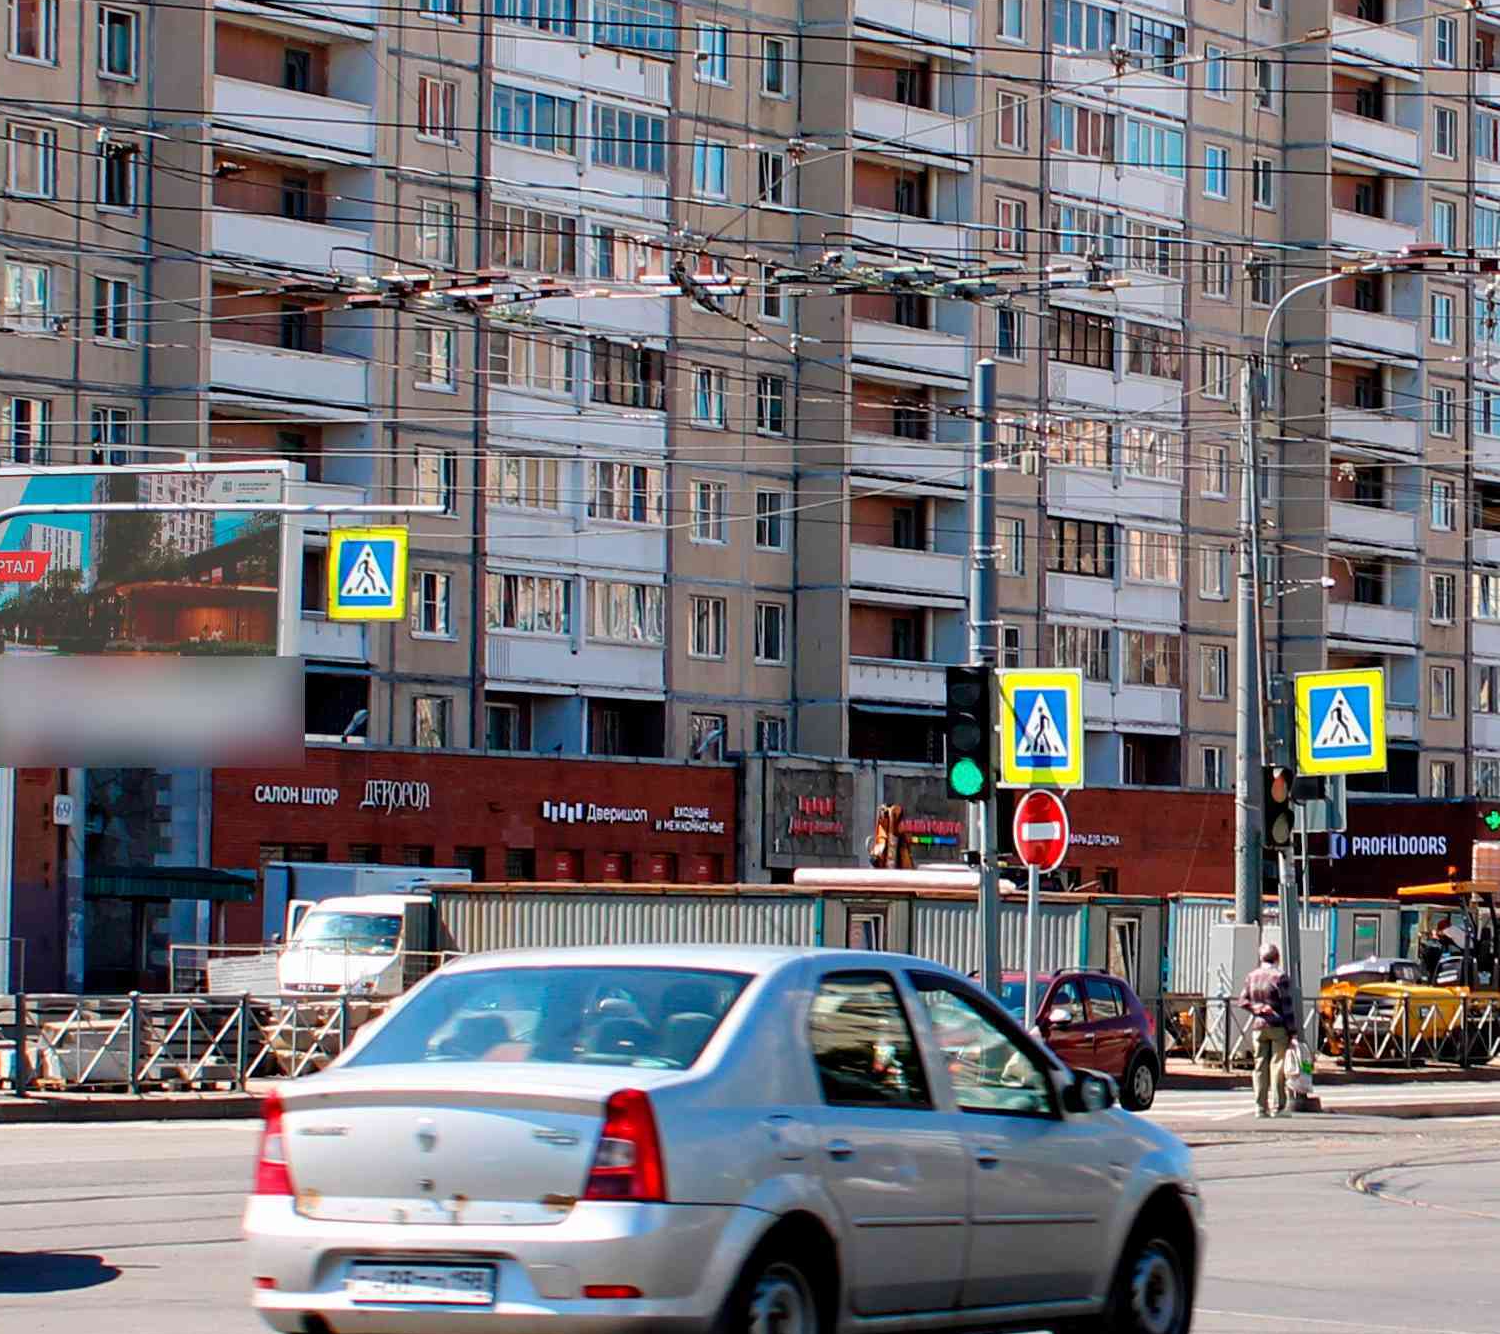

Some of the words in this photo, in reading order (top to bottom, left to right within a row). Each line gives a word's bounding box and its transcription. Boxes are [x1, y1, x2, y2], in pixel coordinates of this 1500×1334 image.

[254, 783, 299, 804] САЛОН
[301, 786, 339, 806] ШТОР
[55, 802, 72, 818] 69
[586, 803, 648, 824] Дверишоп
[674, 806, 709, 819] ВХОДНЫЕ
[1351, 835, 1448, 857] PROFILDOORS
